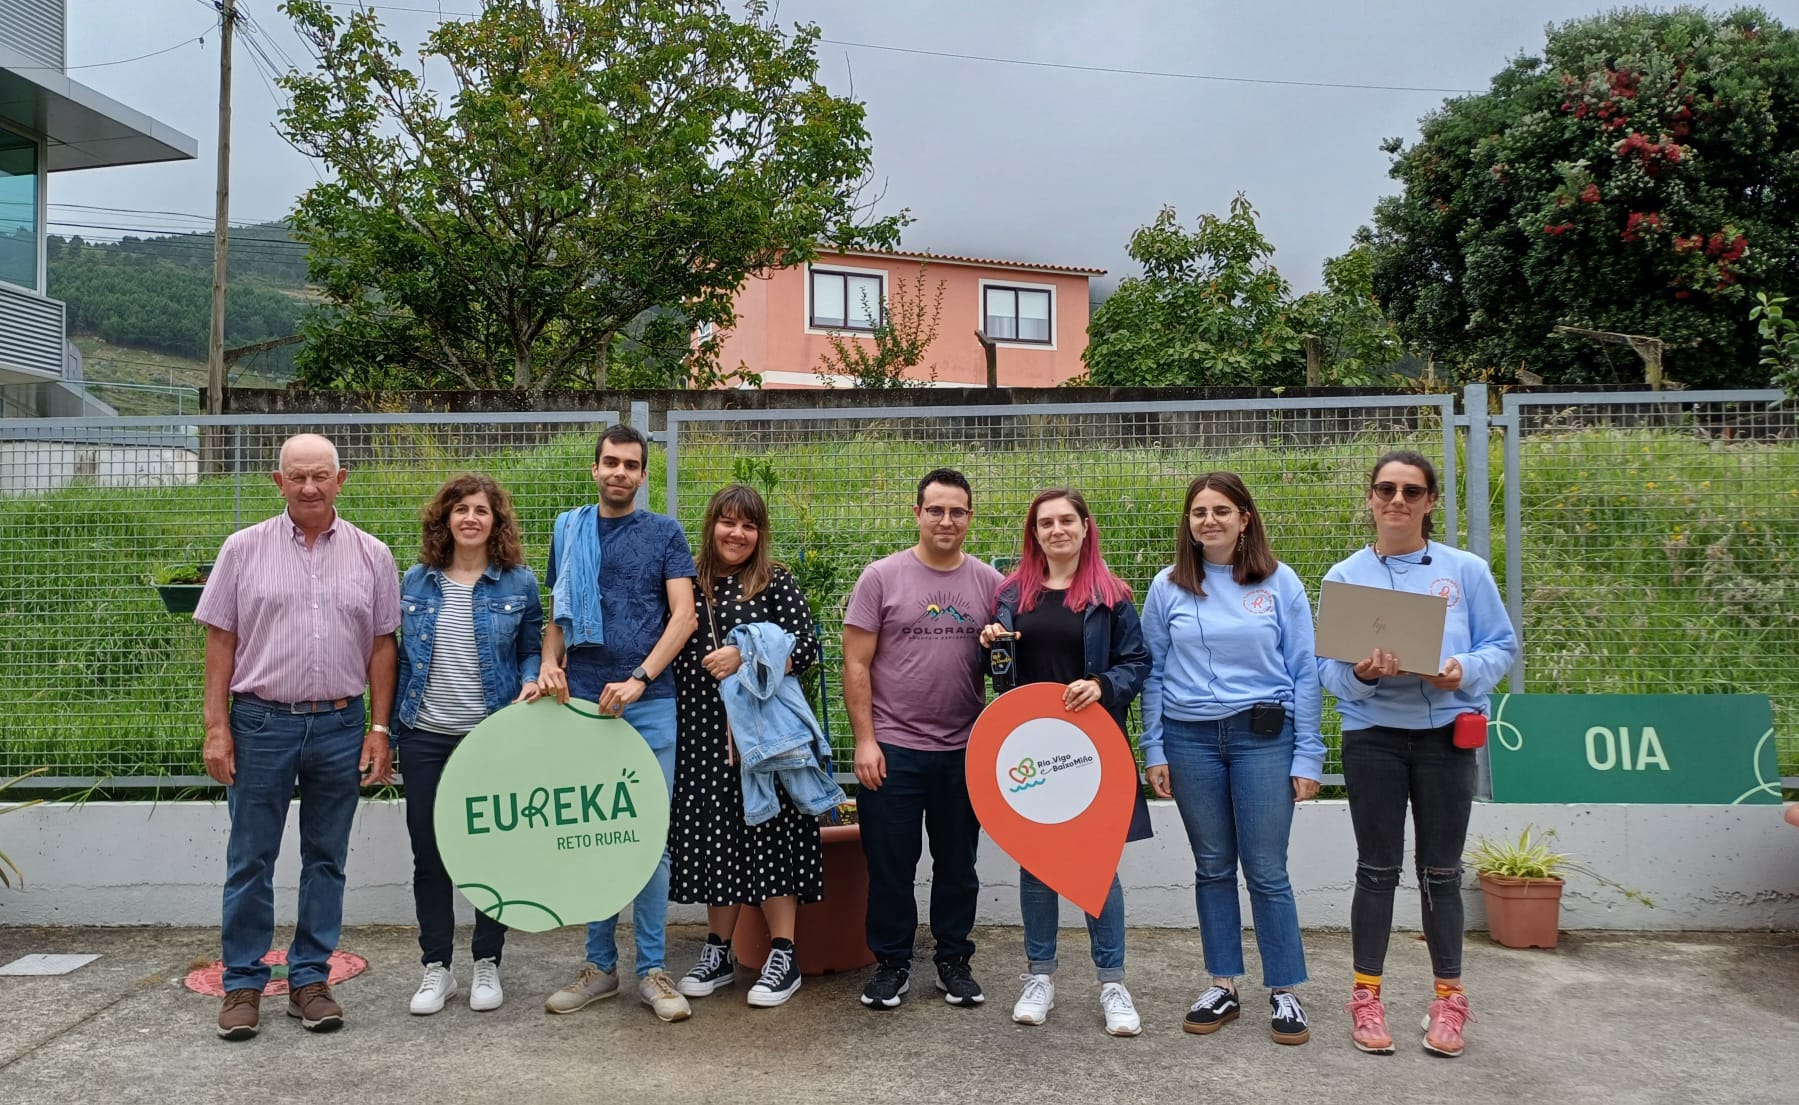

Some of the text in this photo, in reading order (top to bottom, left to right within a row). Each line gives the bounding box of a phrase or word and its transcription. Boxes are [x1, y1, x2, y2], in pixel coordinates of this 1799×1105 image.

[1584, 726, 1670, 771] OIA
[465, 781, 637, 835] EUREKA
[557, 829, 640, 850] RETO RURAL
